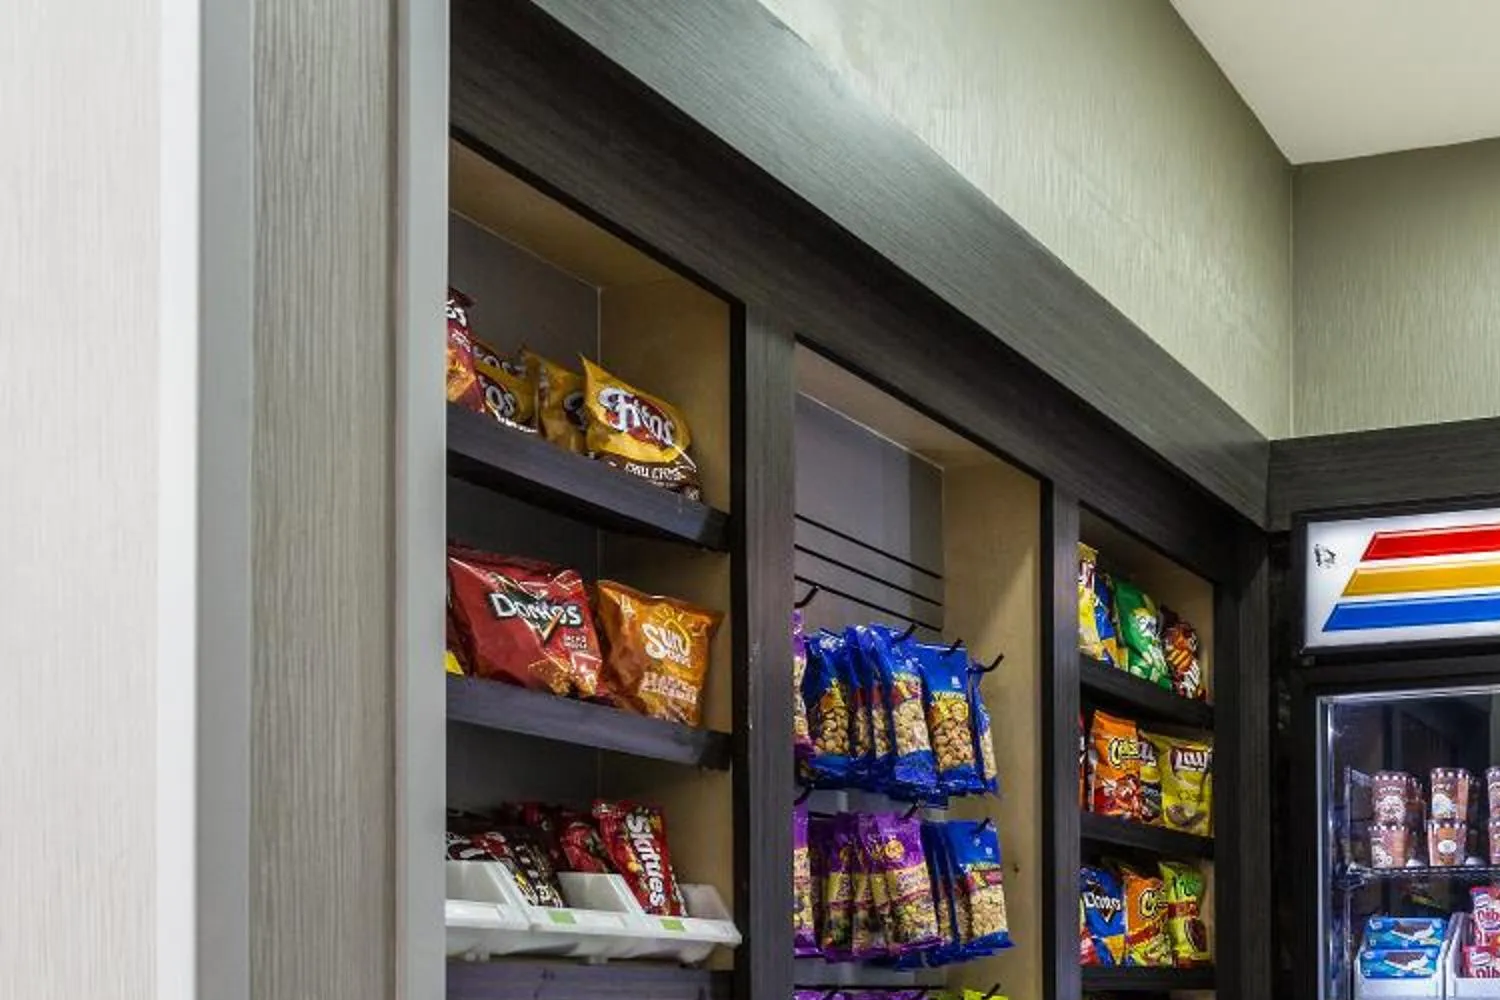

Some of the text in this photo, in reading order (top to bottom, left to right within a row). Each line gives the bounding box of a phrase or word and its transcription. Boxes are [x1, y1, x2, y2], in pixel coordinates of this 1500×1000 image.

[599, 387, 675, 445] Fritos
[488, 593, 583, 626] Doritos
[626, 813, 664, 906] Skittles
